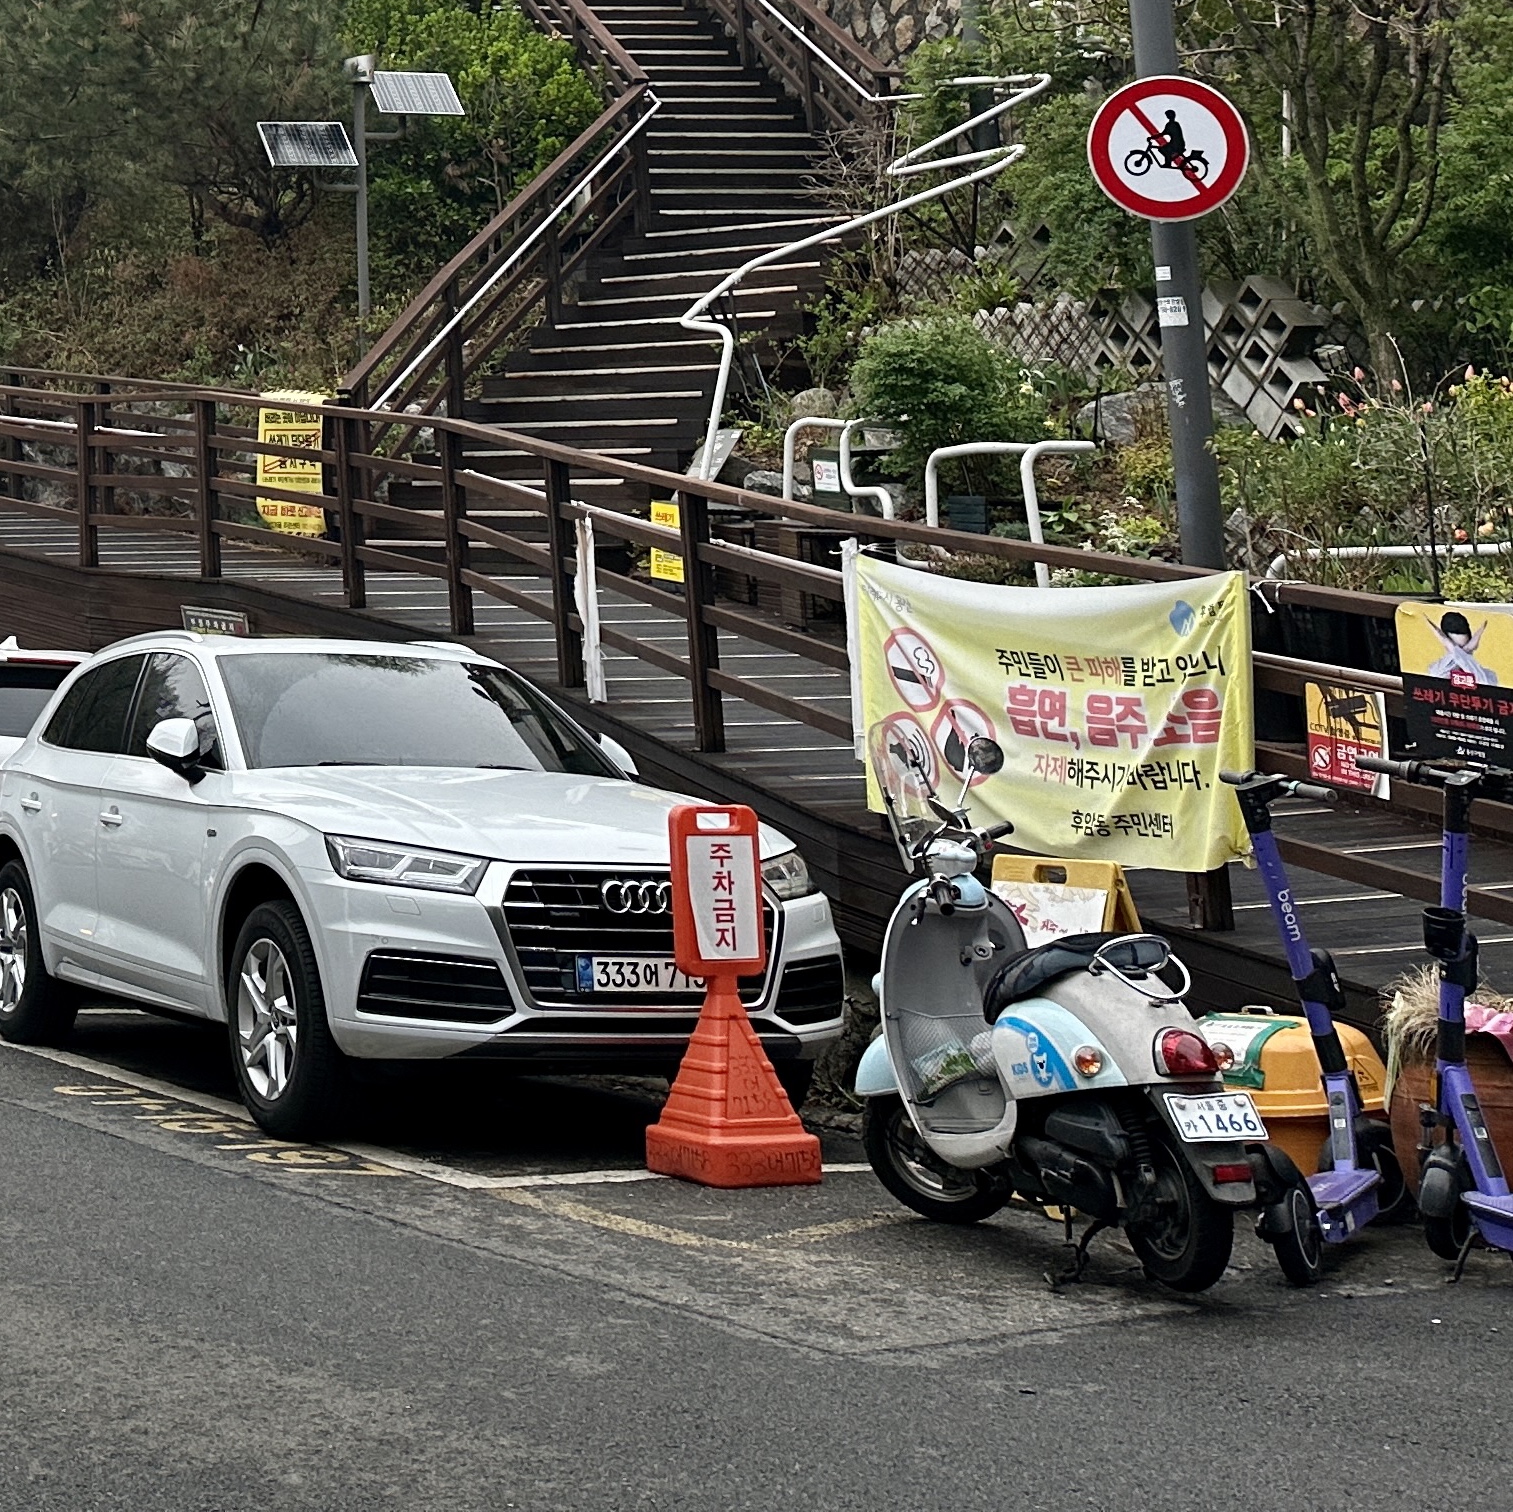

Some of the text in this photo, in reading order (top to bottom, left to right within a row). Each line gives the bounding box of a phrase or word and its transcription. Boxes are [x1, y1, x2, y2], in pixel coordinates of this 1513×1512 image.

[995, 648, 1065, 682] 주민들이
[1064, 655, 1085, 683] 큰
[1084, 656, 1138, 687] 피해를
[1141, 656, 1176, 687] 받고
[1006, 684, 1081, 751] 흡연,
[1085, 693, 1148, 750] 음주
[1412, 687, 1446, 705] 쓰레기
[1448, 692, 1494, 714] 무단투기
[1071, 810, 1174, 839] 후암동 주민센터
[709, 843, 738, 951] 주차금지
[1277, 889, 1302, 942] beam
[1198, 1112, 1258, 1134] 1466
